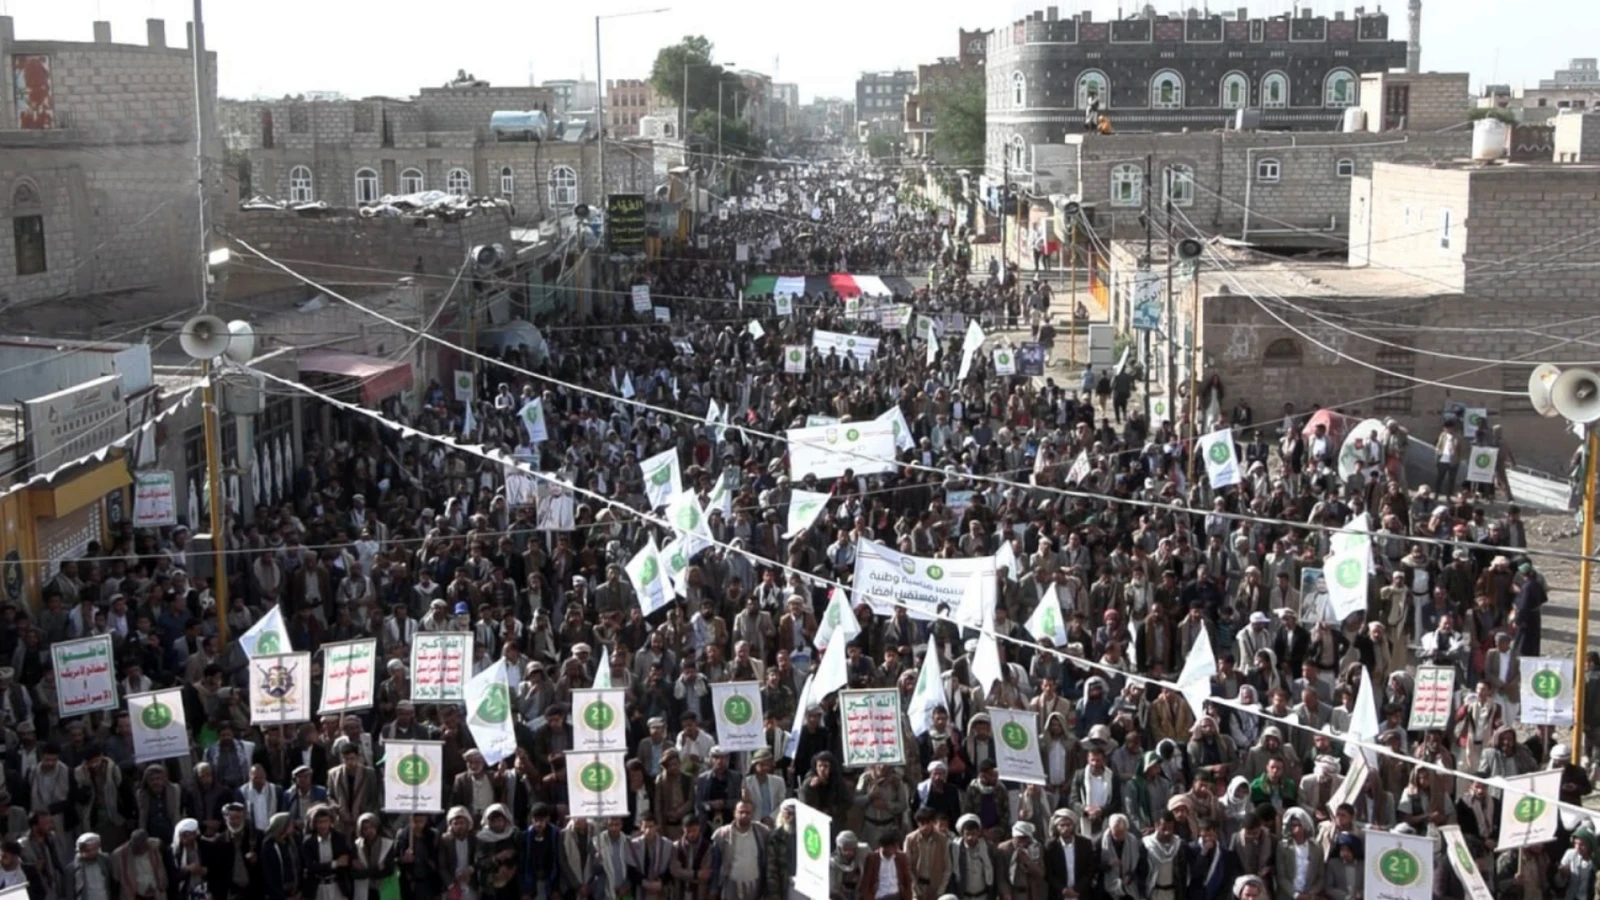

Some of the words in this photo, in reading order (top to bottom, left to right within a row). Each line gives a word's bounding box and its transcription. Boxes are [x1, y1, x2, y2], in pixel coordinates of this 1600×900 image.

[868, 570, 900, 585] وطنية
[444, 639, 463, 649] الله
[1538, 676, 1557, 690] 21
[731, 700, 747, 714] 21
[847, 694, 874, 712] أكبر
[875, 695, 896, 707] الله
[146, 707, 166, 721] 21
[590, 707, 608, 720] 21
[1006, 726, 1023, 741] 21
[404, 762, 424, 776] 21
[589, 769, 607, 783] 21
[1521, 797, 1540, 814] 21
[1388, 857, 1411, 874] 21
